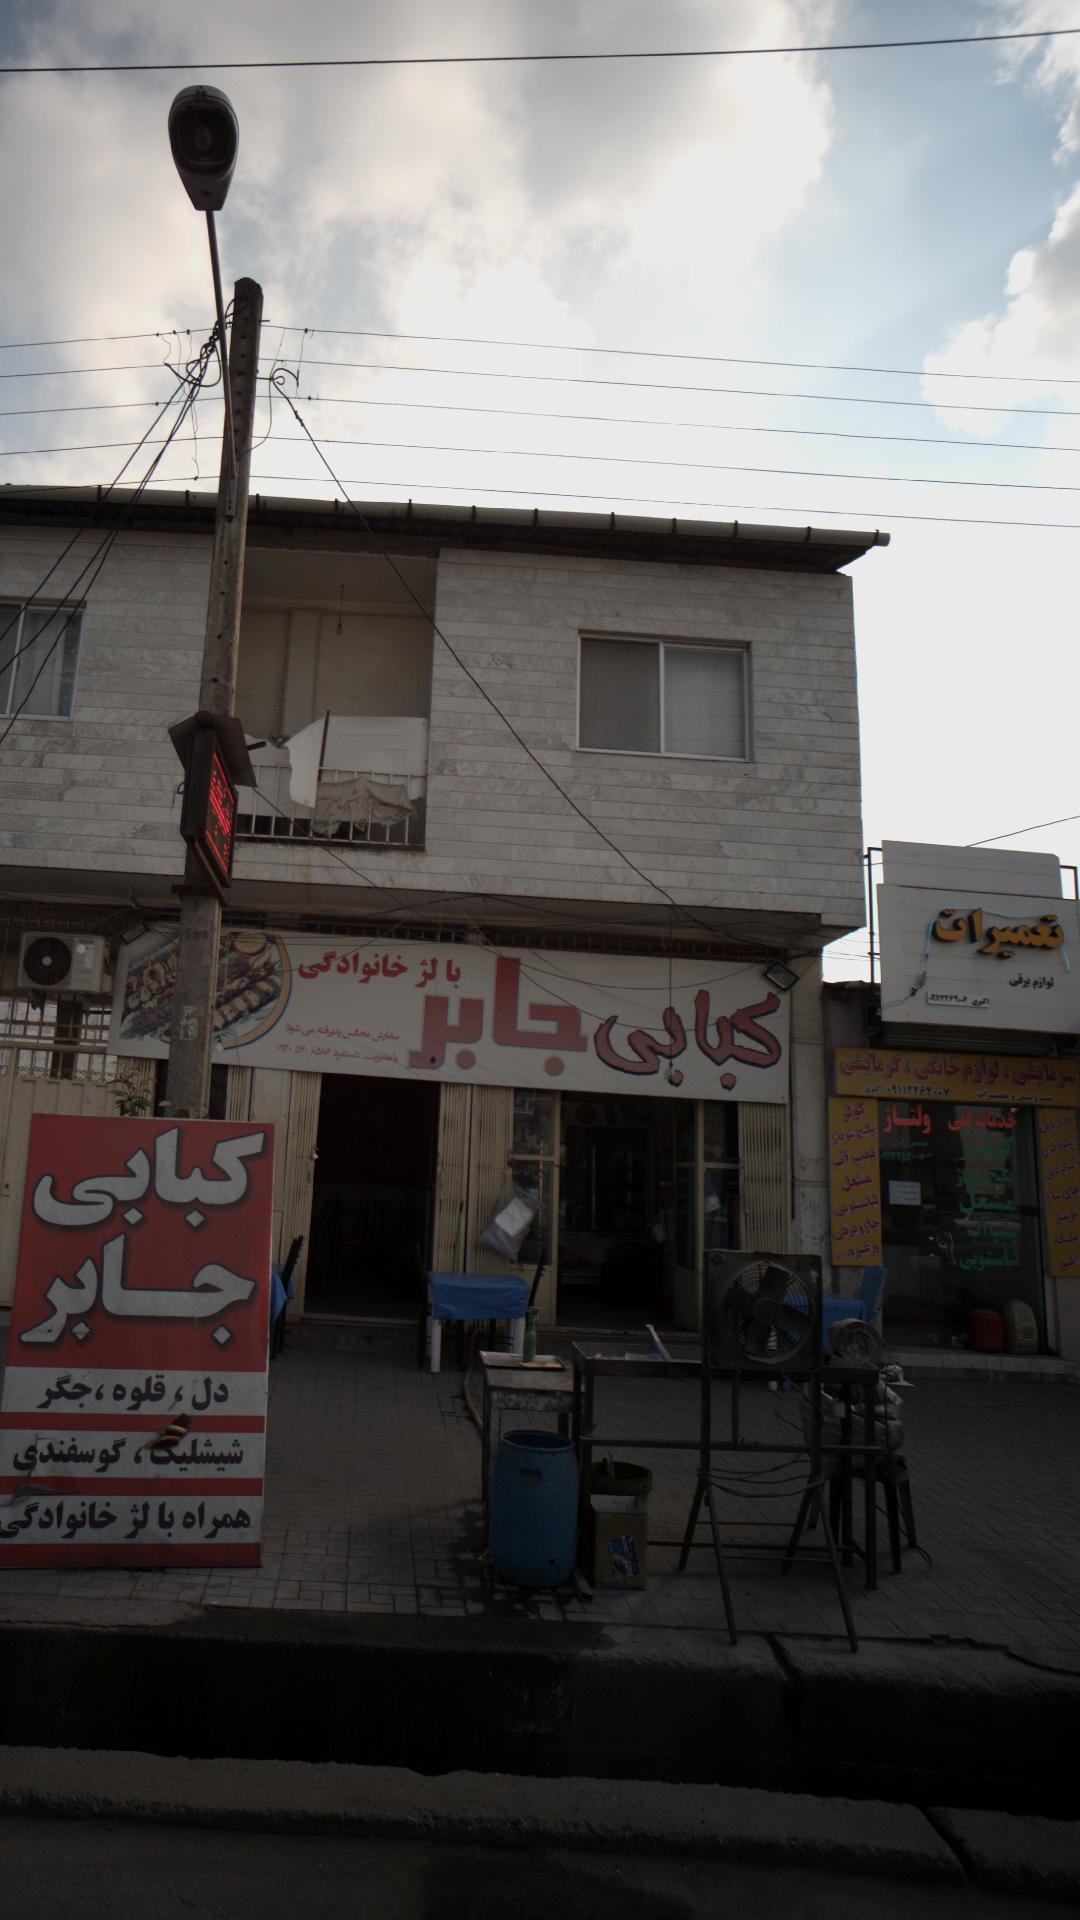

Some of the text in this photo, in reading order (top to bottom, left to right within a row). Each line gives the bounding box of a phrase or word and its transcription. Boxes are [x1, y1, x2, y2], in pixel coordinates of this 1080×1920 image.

[931, 907, 1065, 960] تعمیرات
[298, 951, 462, 989] با لژ خانوادگی
[1008, 973, 1055, 990] لوازم برقی
[285, 1023, 302, 1036] شود
[317, 1024, 342, 1039] پذیرفته
[342, 1026, 371, 1040] مجالس
[371, 1027, 401, 1042] سفارش
[409, 956, 784, 1089] کبابی جابر
[839, 1050, 902, 1080] گرمایشی
[962, 1055, 1001, 1085] لوازم
[881, 1103, 934, 1136] ولتاژ
[974, 1107, 1019, 1131] خدمات
[31, 1125, 265, 1229] کبابی
[958, 1190, 1018, 1214] مشعل
[18, 1231, 258, 1346] جابر
[12, 1435, 126, 1473] گوسفندی
[0, 1498, 251, 1540] همراه با لژ خانوادگی
